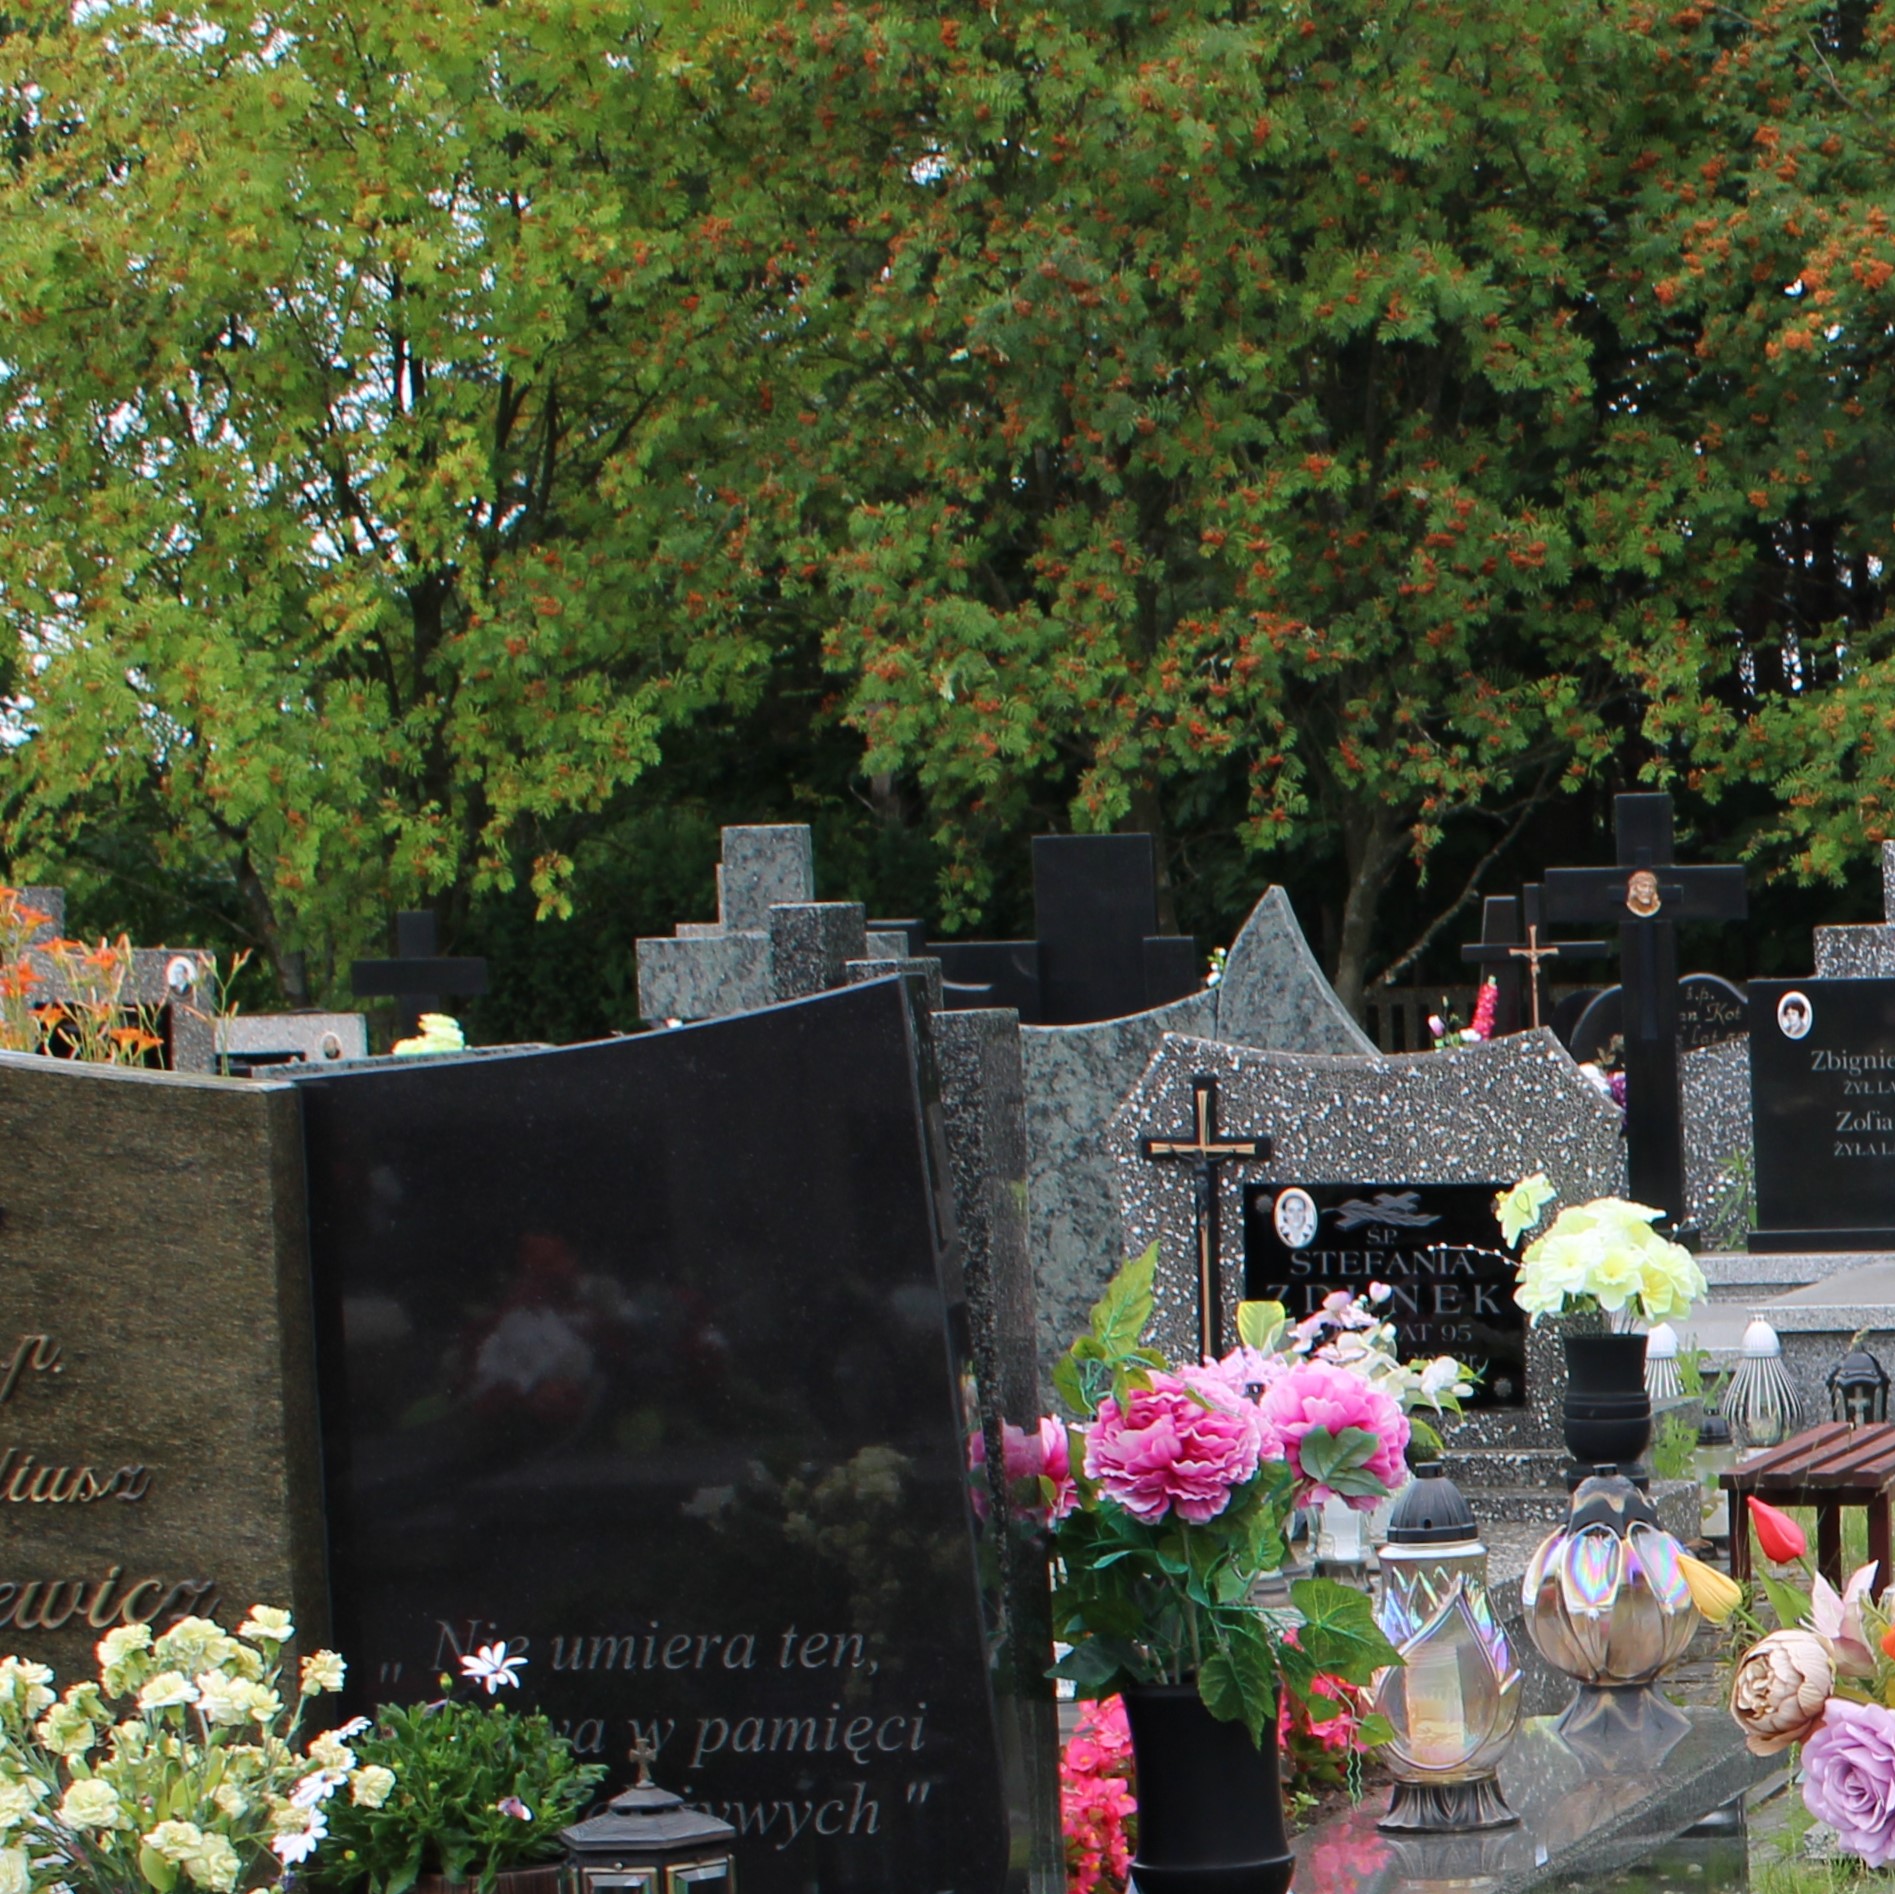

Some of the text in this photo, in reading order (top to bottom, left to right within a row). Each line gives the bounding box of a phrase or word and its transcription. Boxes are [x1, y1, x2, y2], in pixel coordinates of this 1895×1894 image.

[1843, 1079, 1872, 1095] ŻYŁ
[1836, 1111, 1893, 1132] Zofia
[1834, 1141, 1877, 1157] ŻYŁA
[1290, 1251, 1475, 1276] STEFANIA
[1441, 1324, 1472, 1343] 95
[551, 1620, 755, 1671] umiera
[779, 1623, 879, 1674] ten,
[690, 1702, 928, 1768] pamięci
